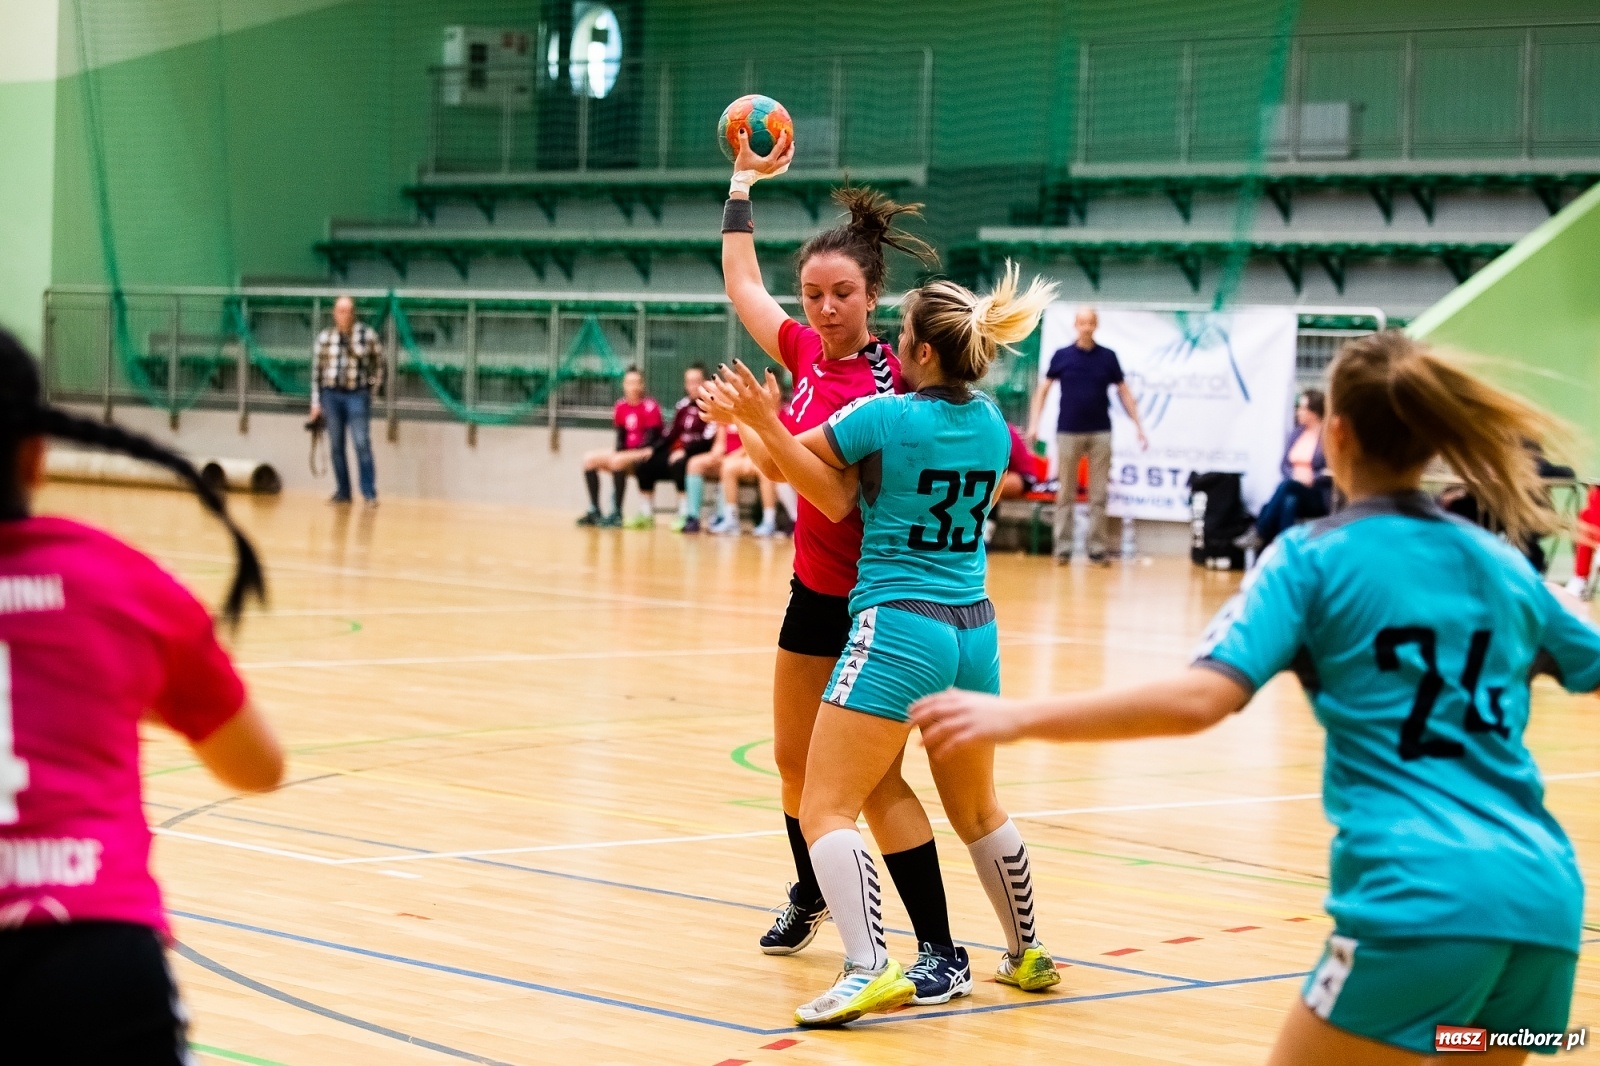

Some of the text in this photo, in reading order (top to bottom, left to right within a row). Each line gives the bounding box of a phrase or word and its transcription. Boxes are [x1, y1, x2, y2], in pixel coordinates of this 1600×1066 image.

[790, 376, 814, 423] 21
[907, 469, 997, 553] 33
[1375, 626, 1511, 761] 24
